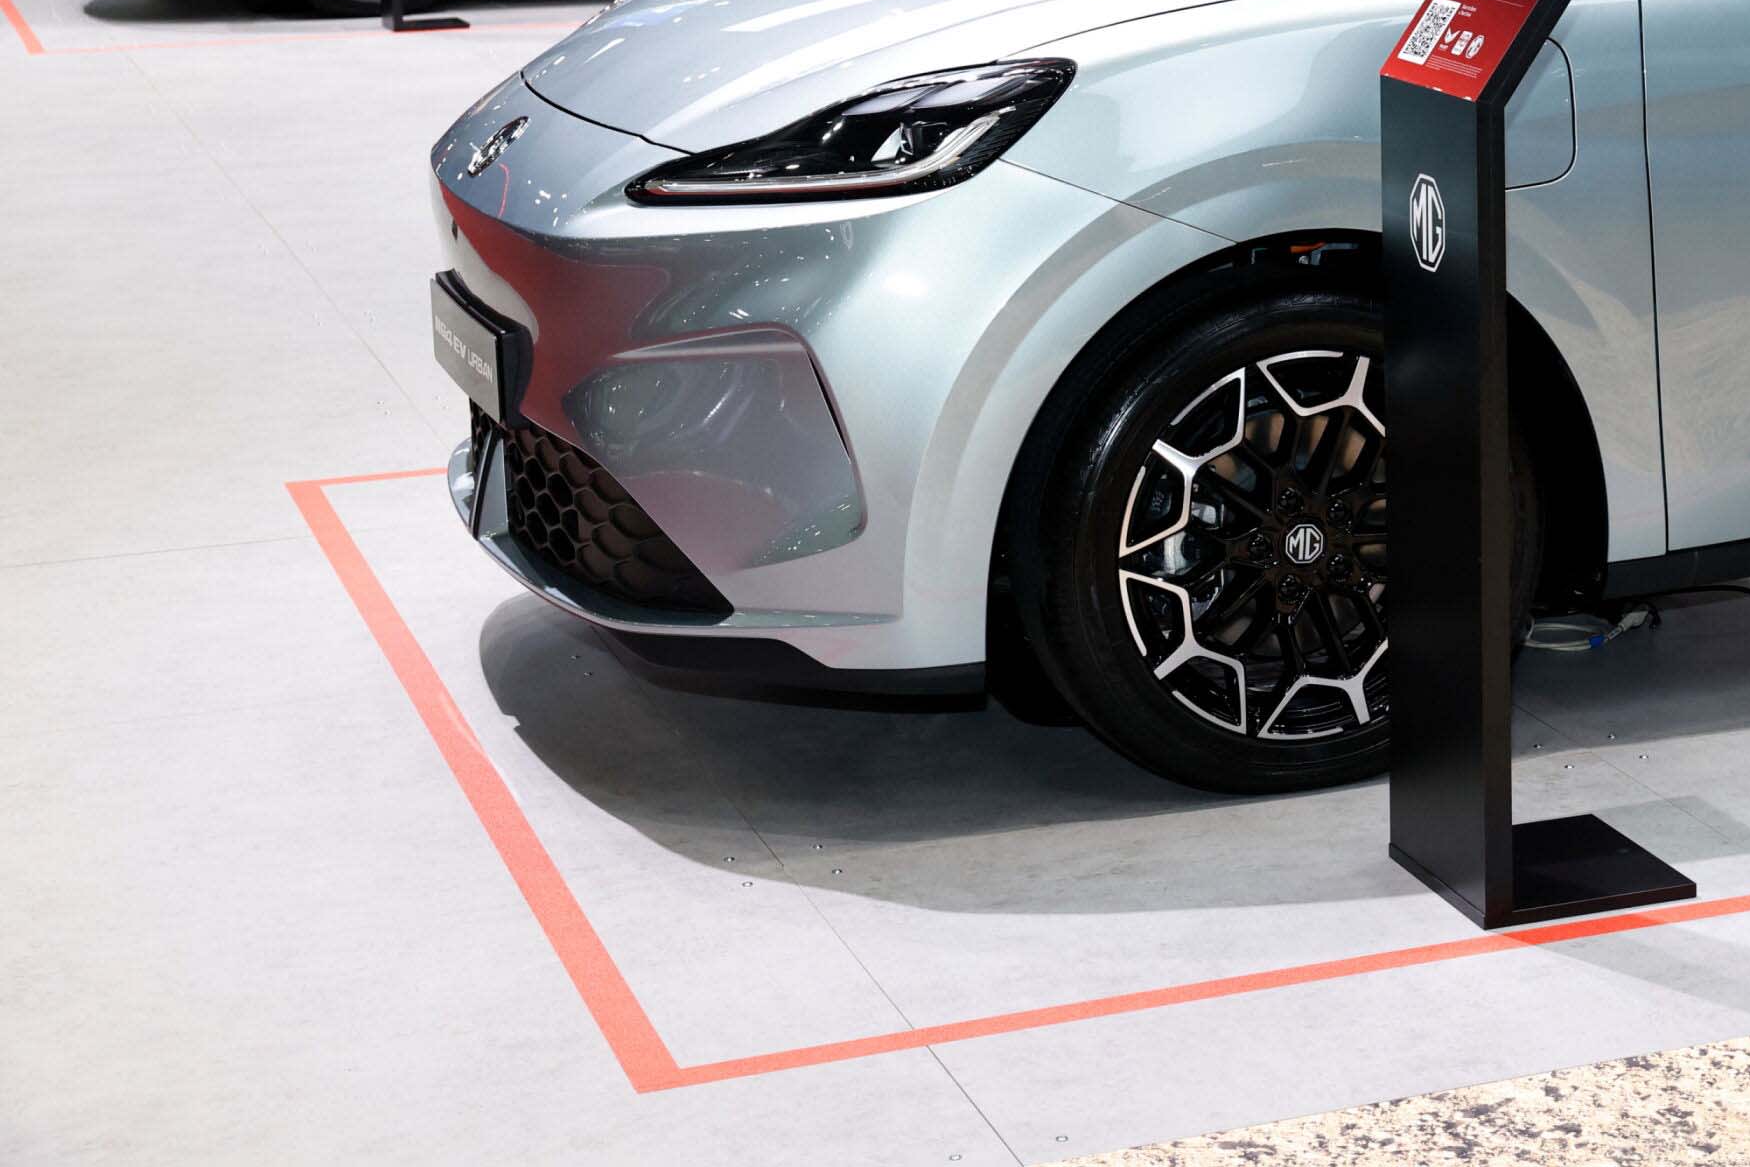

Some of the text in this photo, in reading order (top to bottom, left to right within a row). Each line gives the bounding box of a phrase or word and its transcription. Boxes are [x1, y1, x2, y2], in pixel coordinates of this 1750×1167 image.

[1411, 178, 1444, 267] MG
[453, 336, 467, 359] EV
[467, 347, 493, 384] URBAN
[1287, 526, 1322, 562] MG
